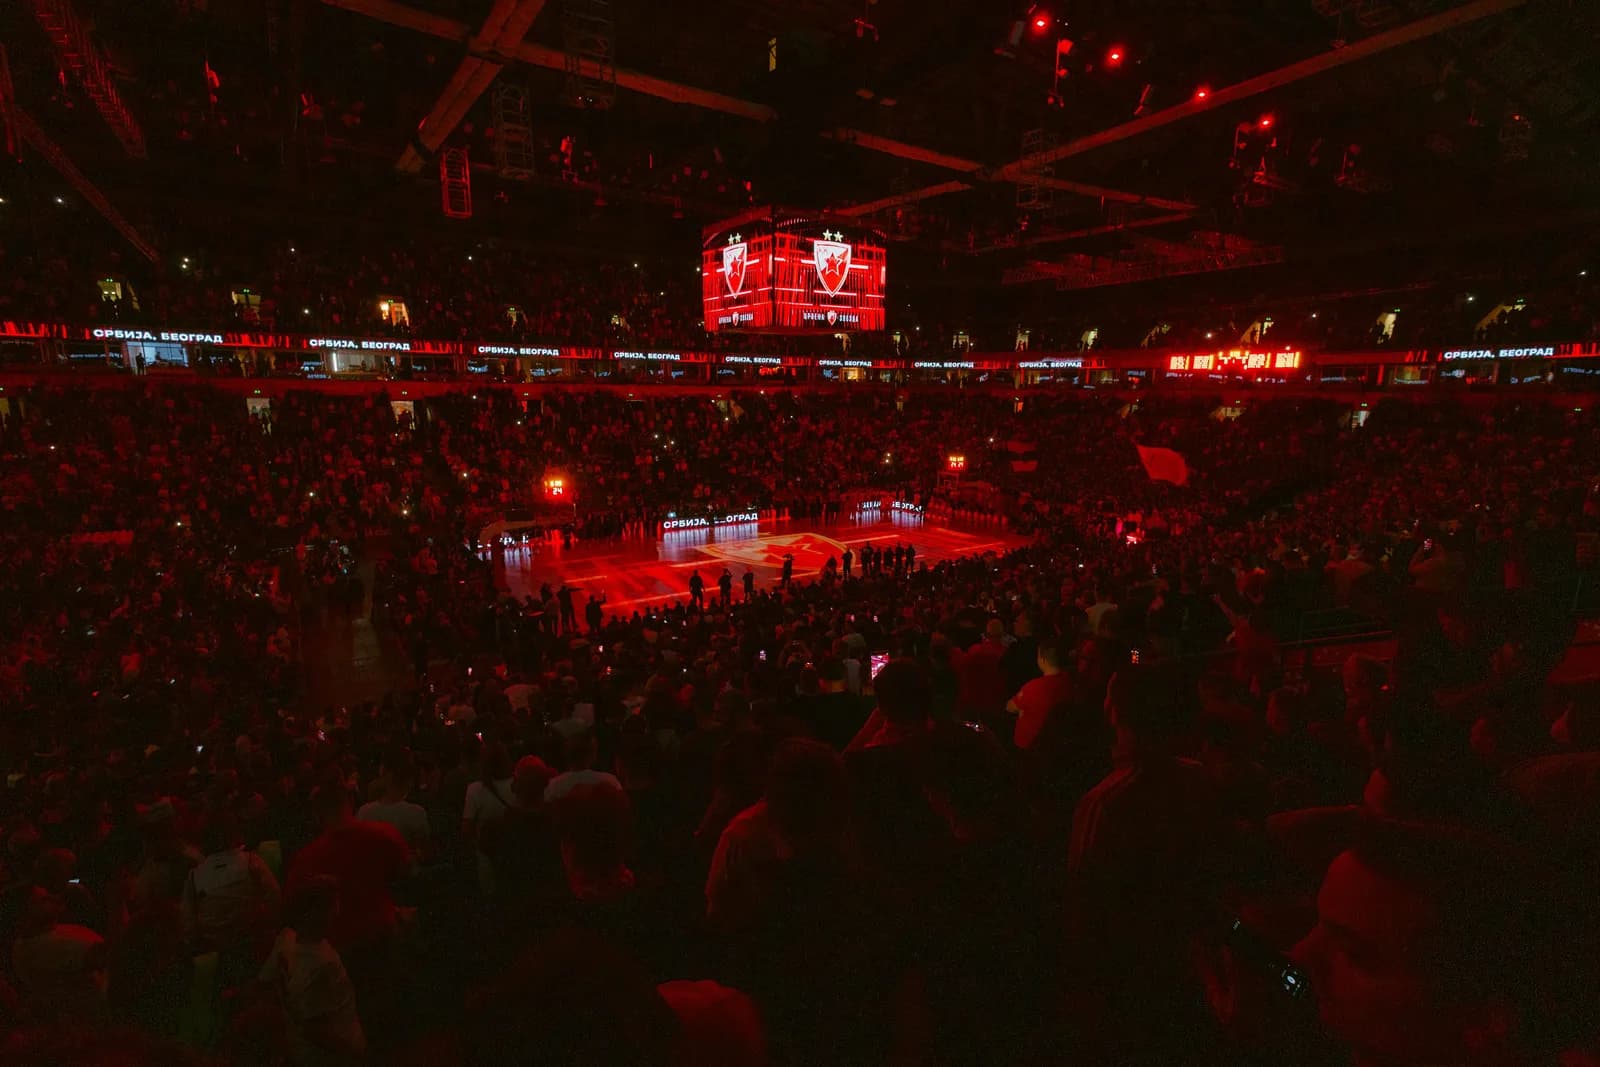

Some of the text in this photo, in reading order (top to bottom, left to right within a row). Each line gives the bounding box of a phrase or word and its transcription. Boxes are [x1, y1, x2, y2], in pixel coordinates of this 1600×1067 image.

[93, 328, 223, 344] СРБИЈА, БЕОГРАД
[309, 339, 410, 351] СРБИЈА, БЕОГРАД
[477, 346, 560, 357] СРБИЈА, БЕОГРАД
[1444, 347, 1554, 359] СРБИЈА, БЕОГРАД
[663, 512, 759, 529] СРБИЈА, ОГРАД
